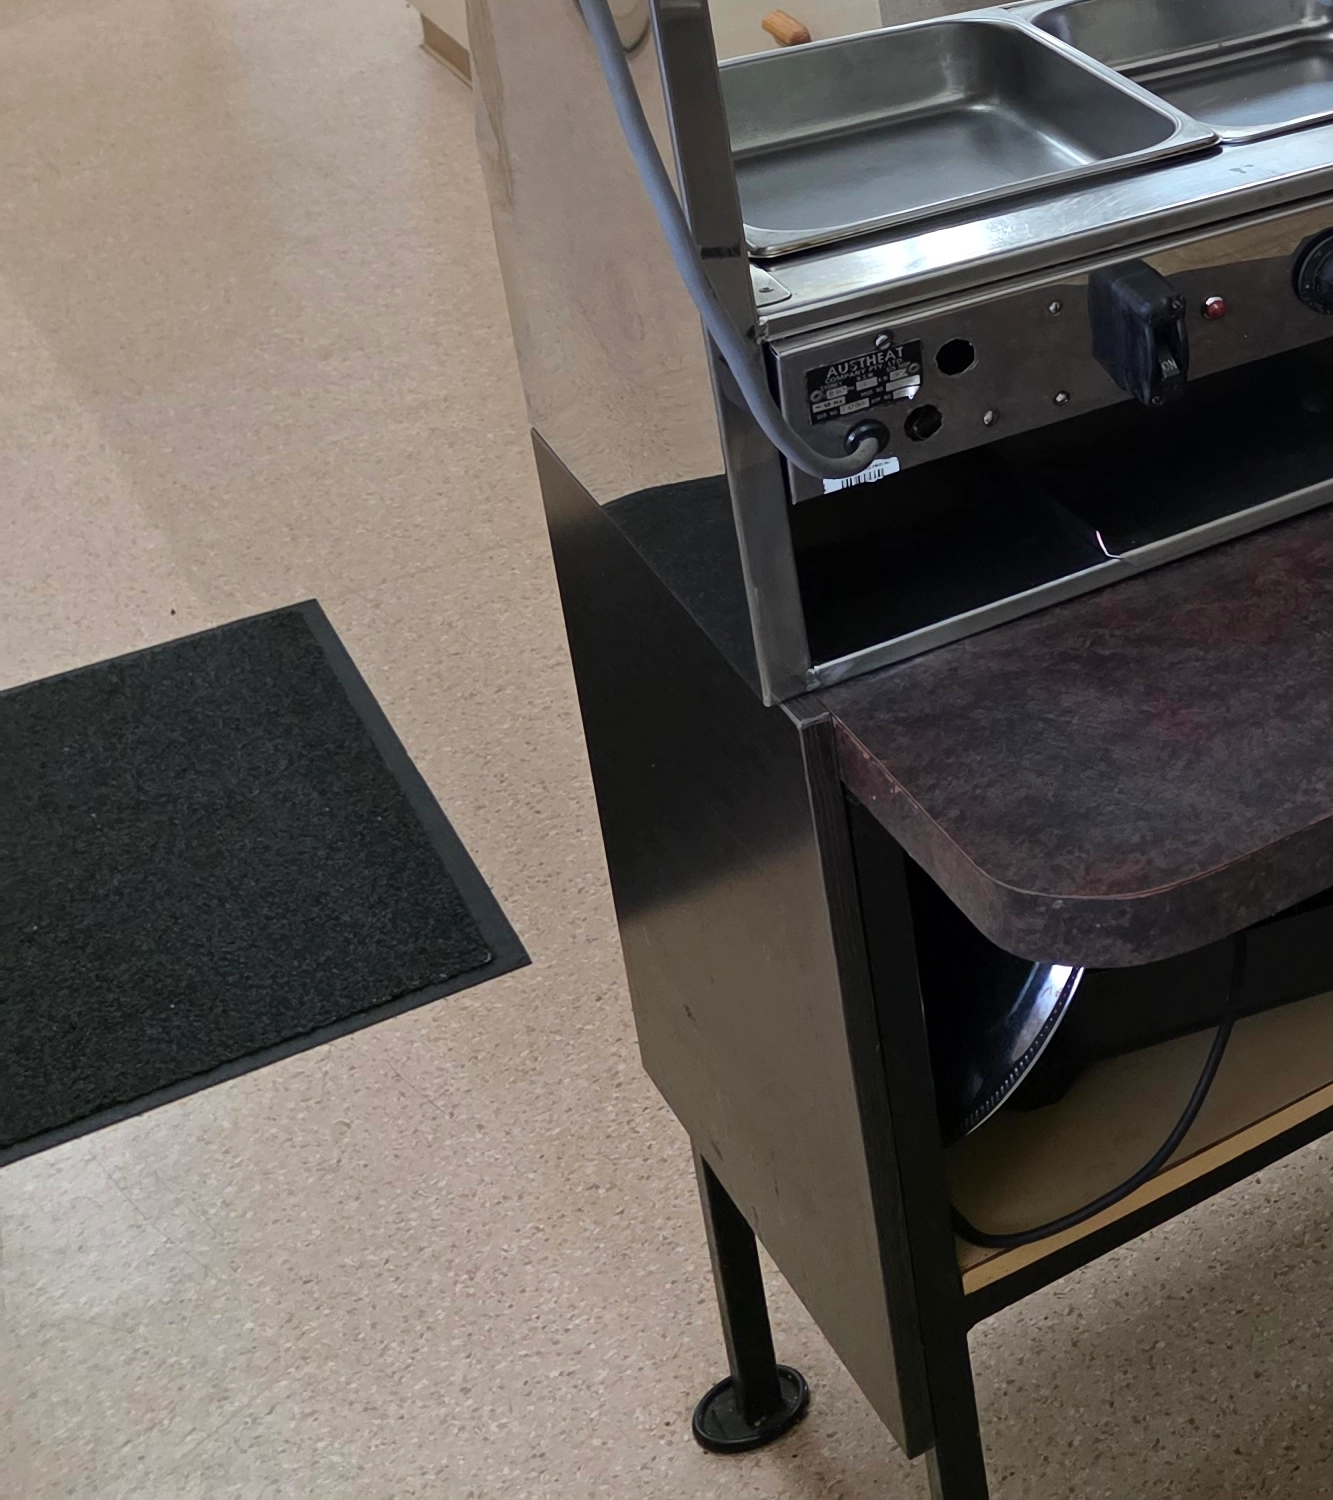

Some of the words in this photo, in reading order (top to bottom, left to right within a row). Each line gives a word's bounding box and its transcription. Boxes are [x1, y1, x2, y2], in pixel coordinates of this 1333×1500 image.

[827, 346, 904, 378] AUSTHEAT
[1161, 358, 1177, 372] ON
[825, 367, 867, 384] COMPANY
